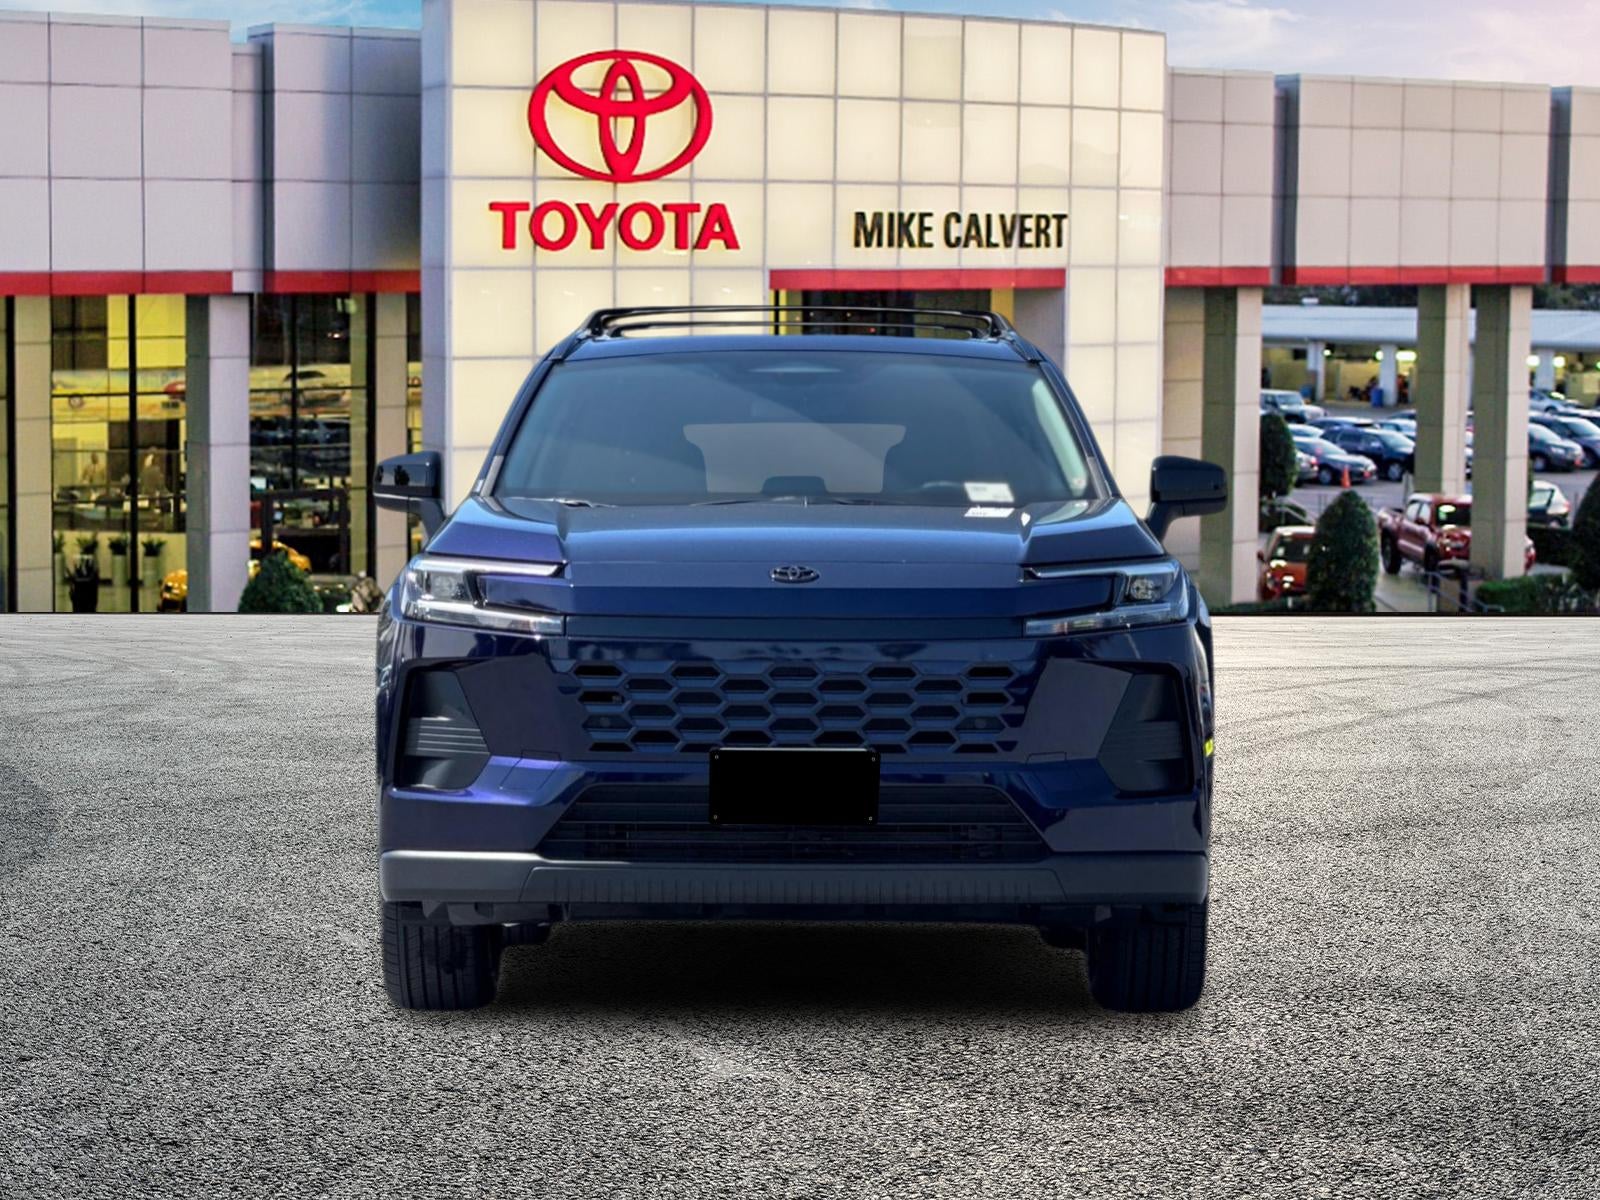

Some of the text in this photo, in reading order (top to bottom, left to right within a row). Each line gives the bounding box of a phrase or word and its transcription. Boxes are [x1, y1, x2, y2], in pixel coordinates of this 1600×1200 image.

[489, 201, 740, 250] TOYOTA
[854, 212, 1068, 248] MIKE CALVERT
